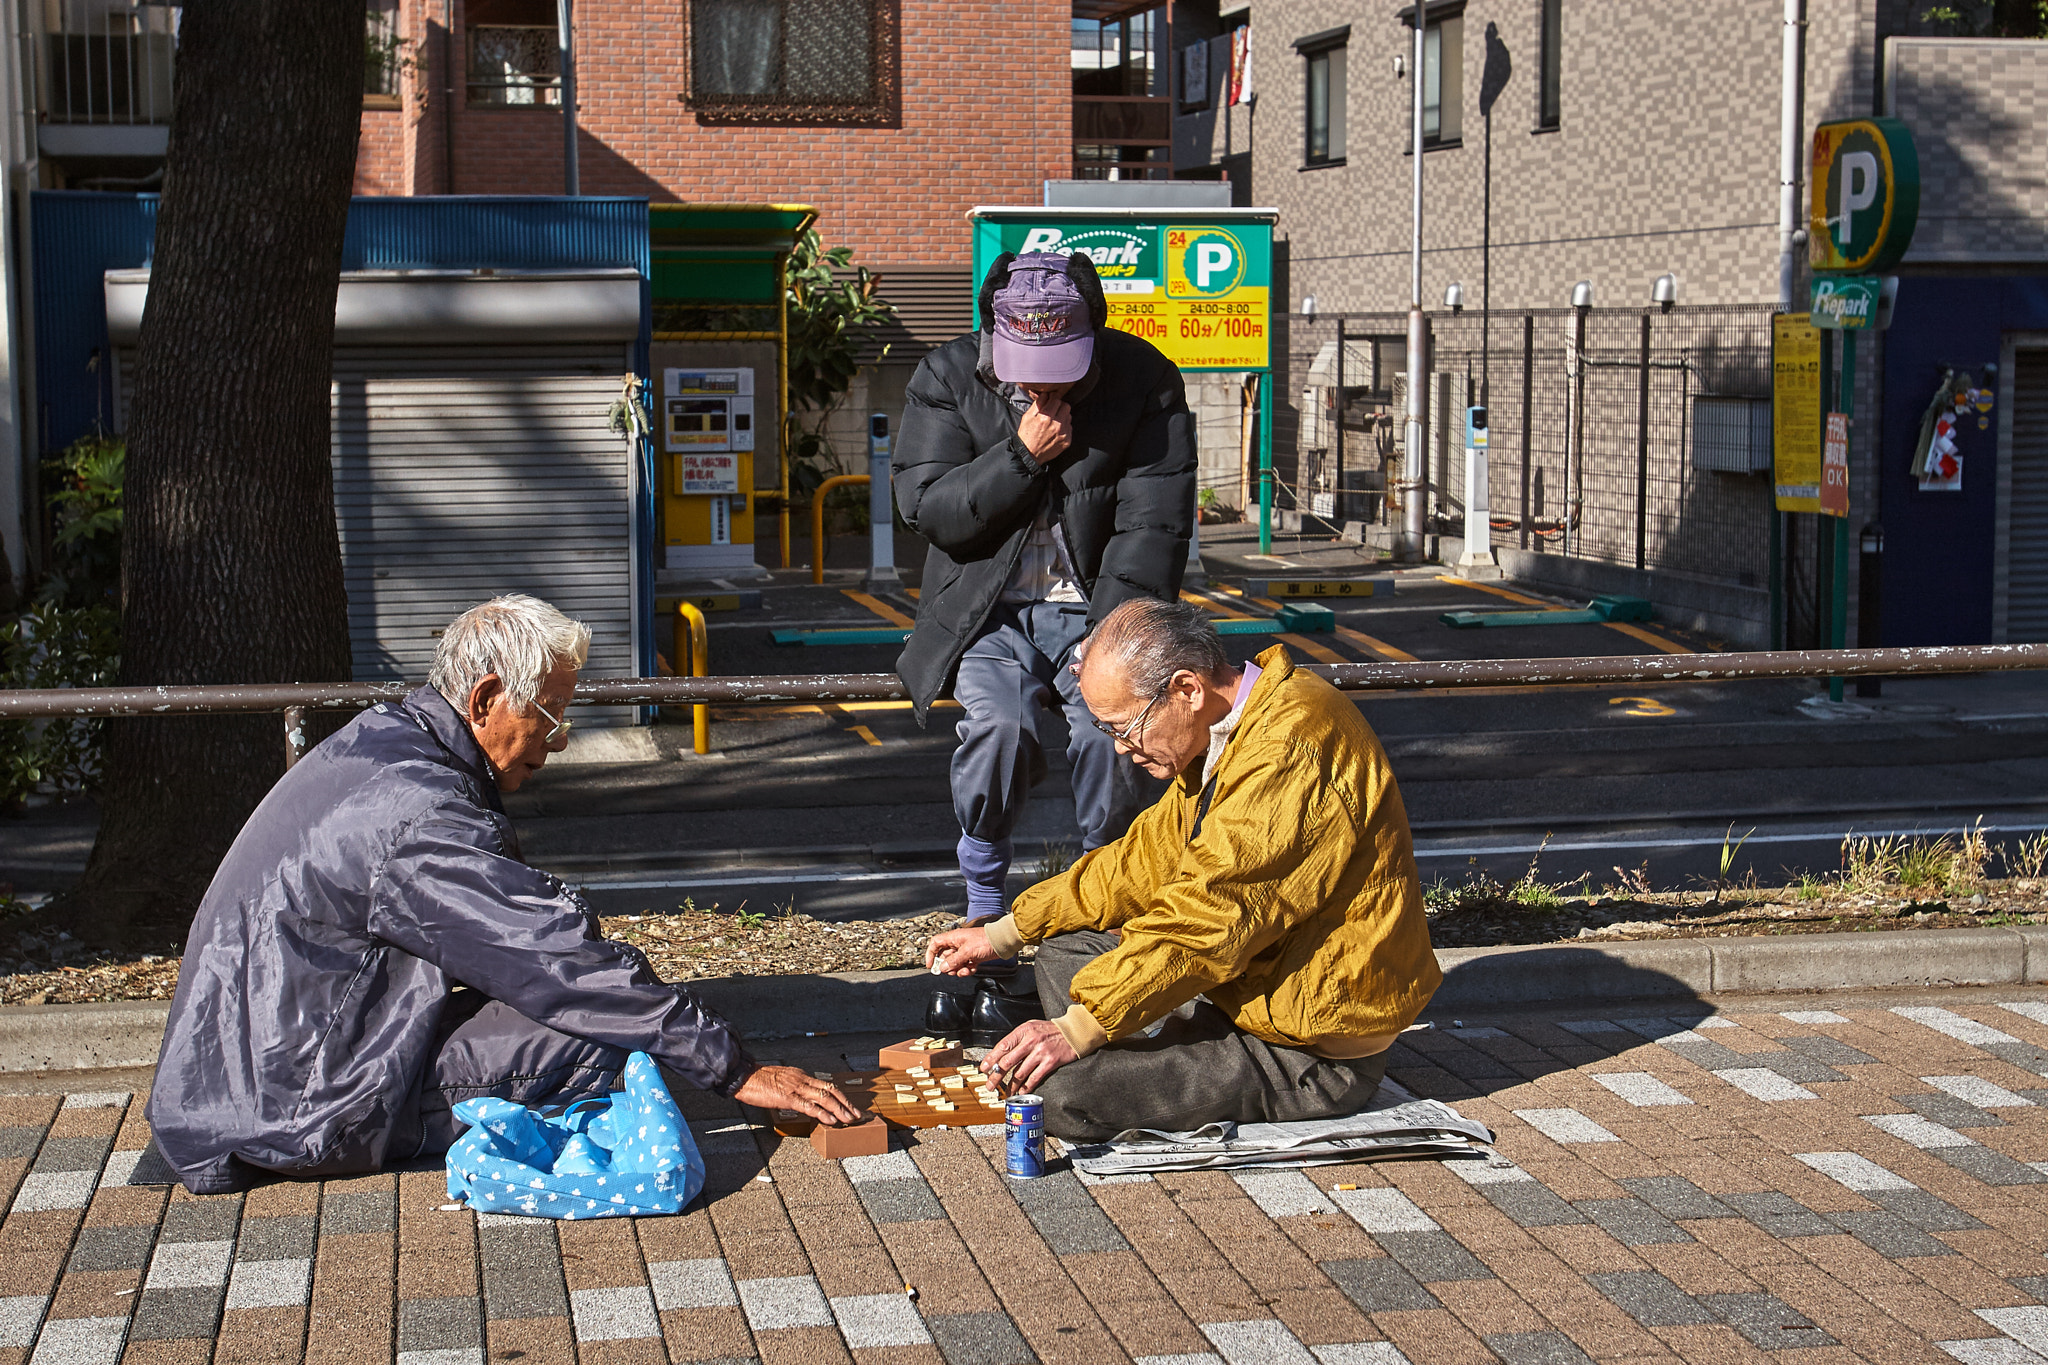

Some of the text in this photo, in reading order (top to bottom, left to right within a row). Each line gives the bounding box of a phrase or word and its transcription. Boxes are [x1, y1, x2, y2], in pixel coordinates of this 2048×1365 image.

[1839, 151, 1878, 244] P
[1169, 231, 1186, 245] 24
[1197, 243, 1232, 287] P
[1813, 281, 1869, 322] Repark
[1180, 317, 1263, 338] 60分/100円
[1827, 469, 1843, 486] OK
[1287, 583, 1352, 594] 車止め
[1609, 697, 1677, 717] 3
